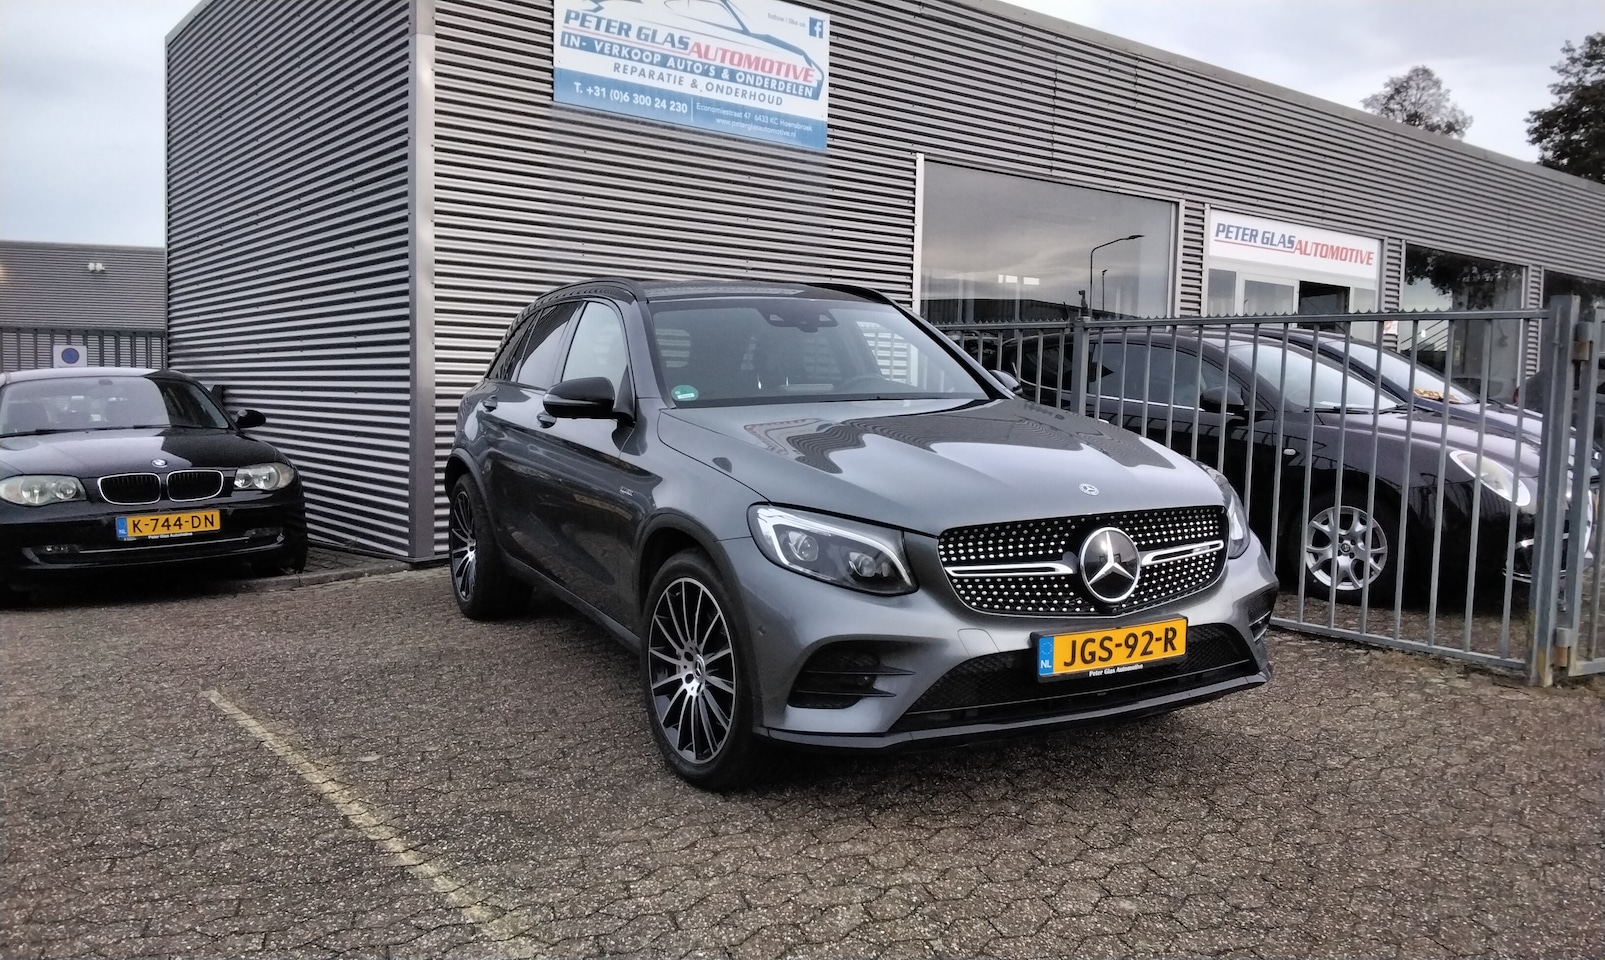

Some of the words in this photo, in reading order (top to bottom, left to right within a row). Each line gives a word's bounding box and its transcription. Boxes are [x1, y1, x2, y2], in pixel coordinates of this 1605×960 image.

[564, 9, 632, 38] PETER
[636, 26, 690, 51] GLAS
[688, 42, 815, 83] AUTOMOTIVE
[564, 34, 587, 48] IN-
[594, 40, 661, 64] VERKOOP
[666, 57, 715, 76] AUTO'S
[721, 69, 730, 80] &
[736, 72, 813, 97] ONDERDELEN
[574, 82, 583, 94] T.
[586, 86, 606, 98] +31
[610, 89, 630, 103] (0)6
[632, 94, 652, 106] 300
[654, 98, 667, 110] 24
[669, 101, 688, 113] 230
[613, 62, 684, 86] REPARATIE
[690, 78, 698, 89] &
[705, 82, 783, 106] ONDERHOUD
[1215, 223, 1258, 244] PETER
[1261, 230, 1296, 249] GLAS
[1294, 240, 1374, 266] AUTOMOTIVE
[132, 514, 214, 534] K-744-DN
[1040, 659, 1052, 669] NL
[1063, 627, 1177, 667] JGS-92-R
